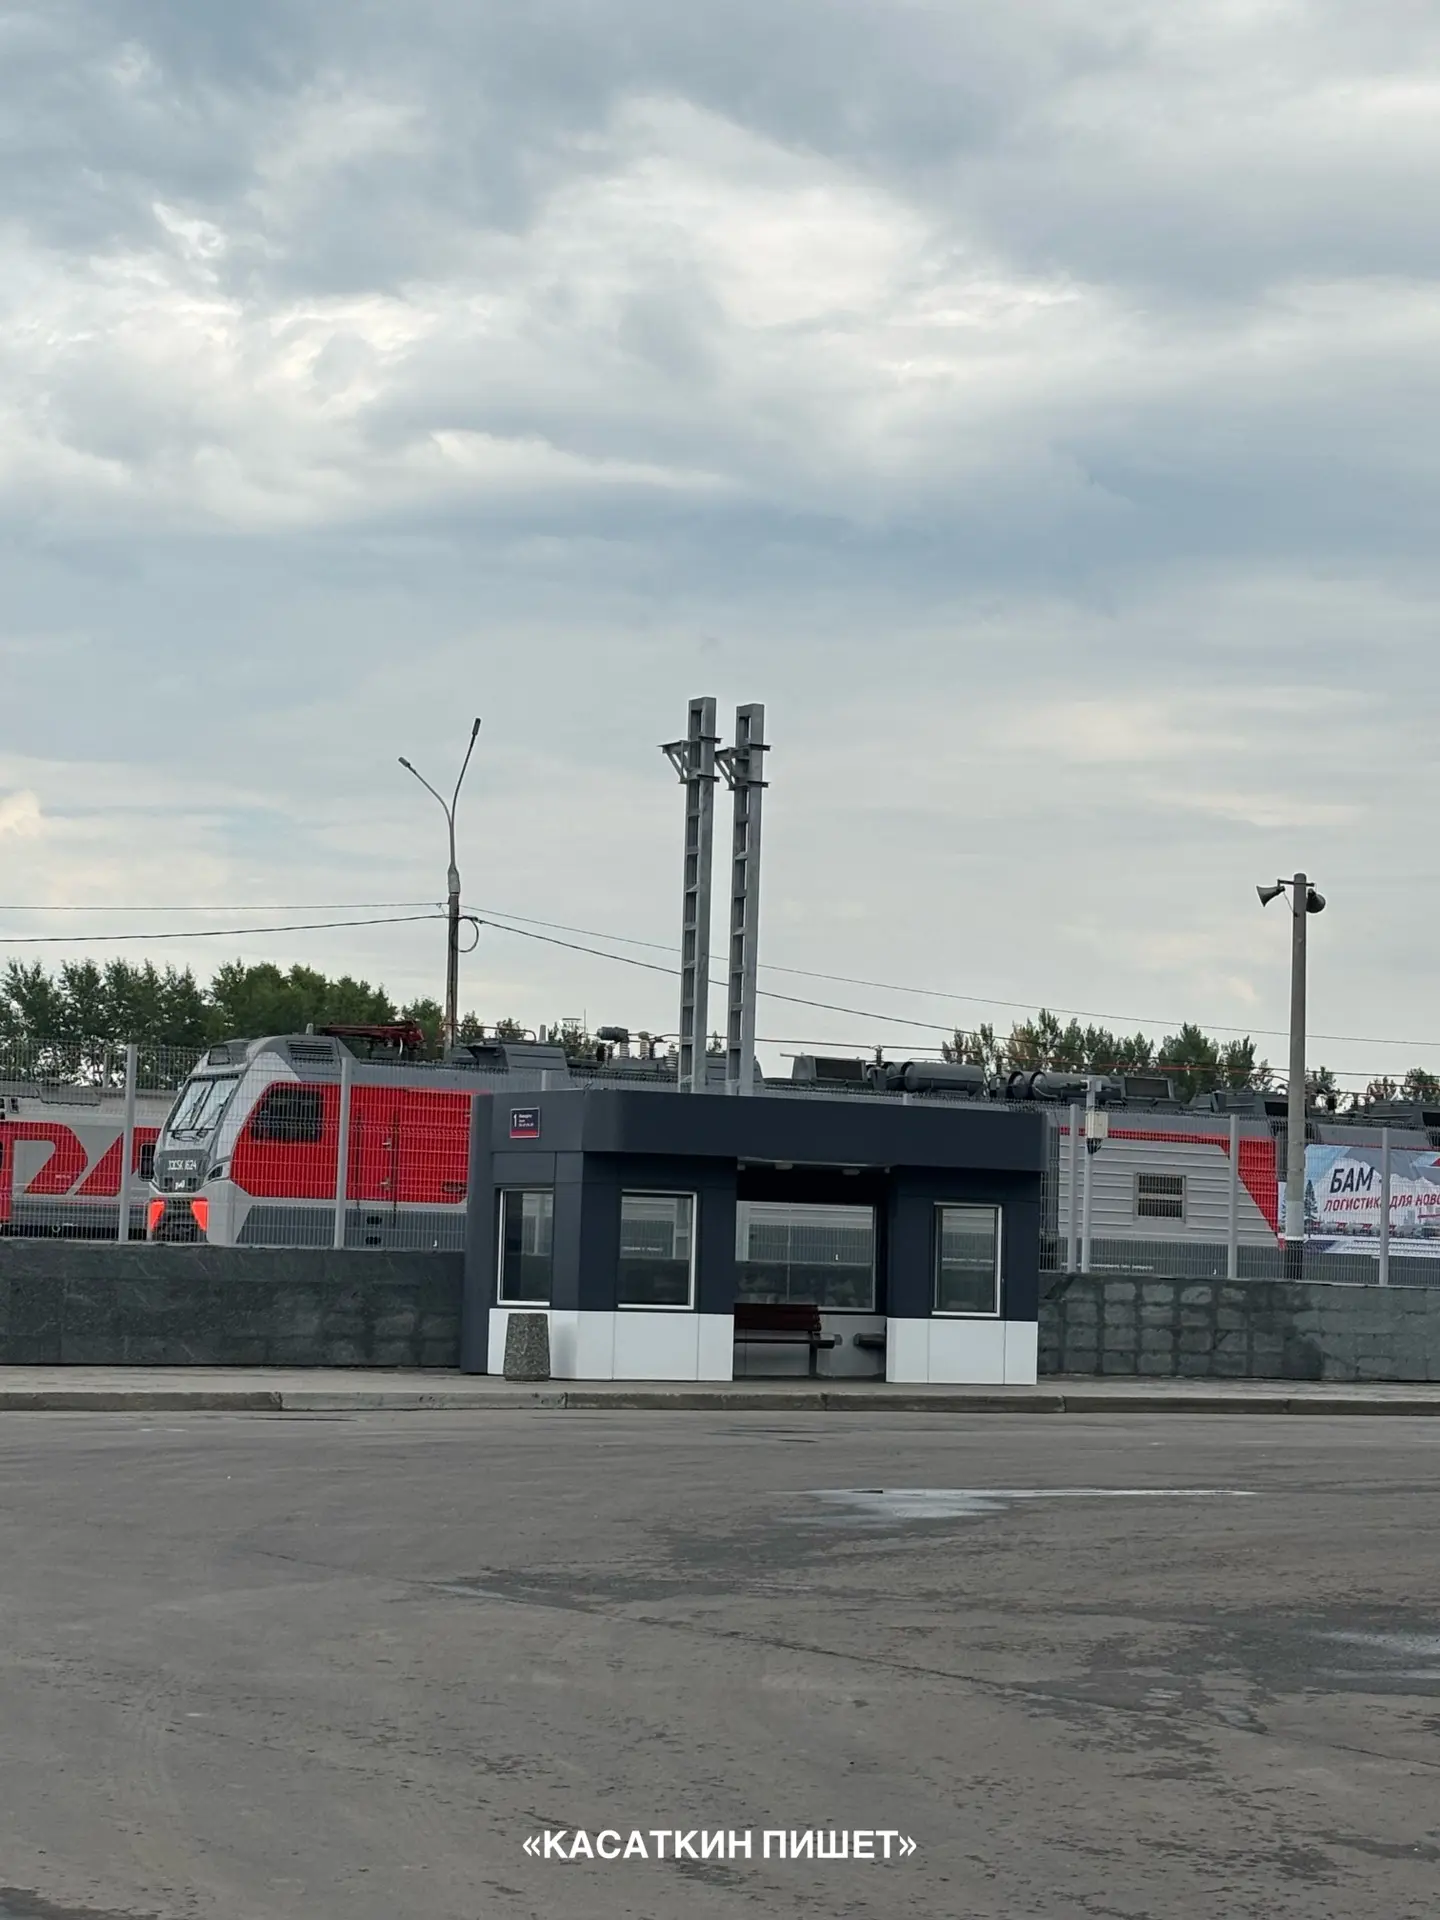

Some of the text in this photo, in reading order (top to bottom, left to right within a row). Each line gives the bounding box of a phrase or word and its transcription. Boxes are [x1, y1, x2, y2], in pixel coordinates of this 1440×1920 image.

[1329, 1166, 1375, 1194] БАМ
[1324, 1196, 1382, 1212] ЛОГИСТИК
[1389, 1194, 1413, 1210] ДЛЯ
